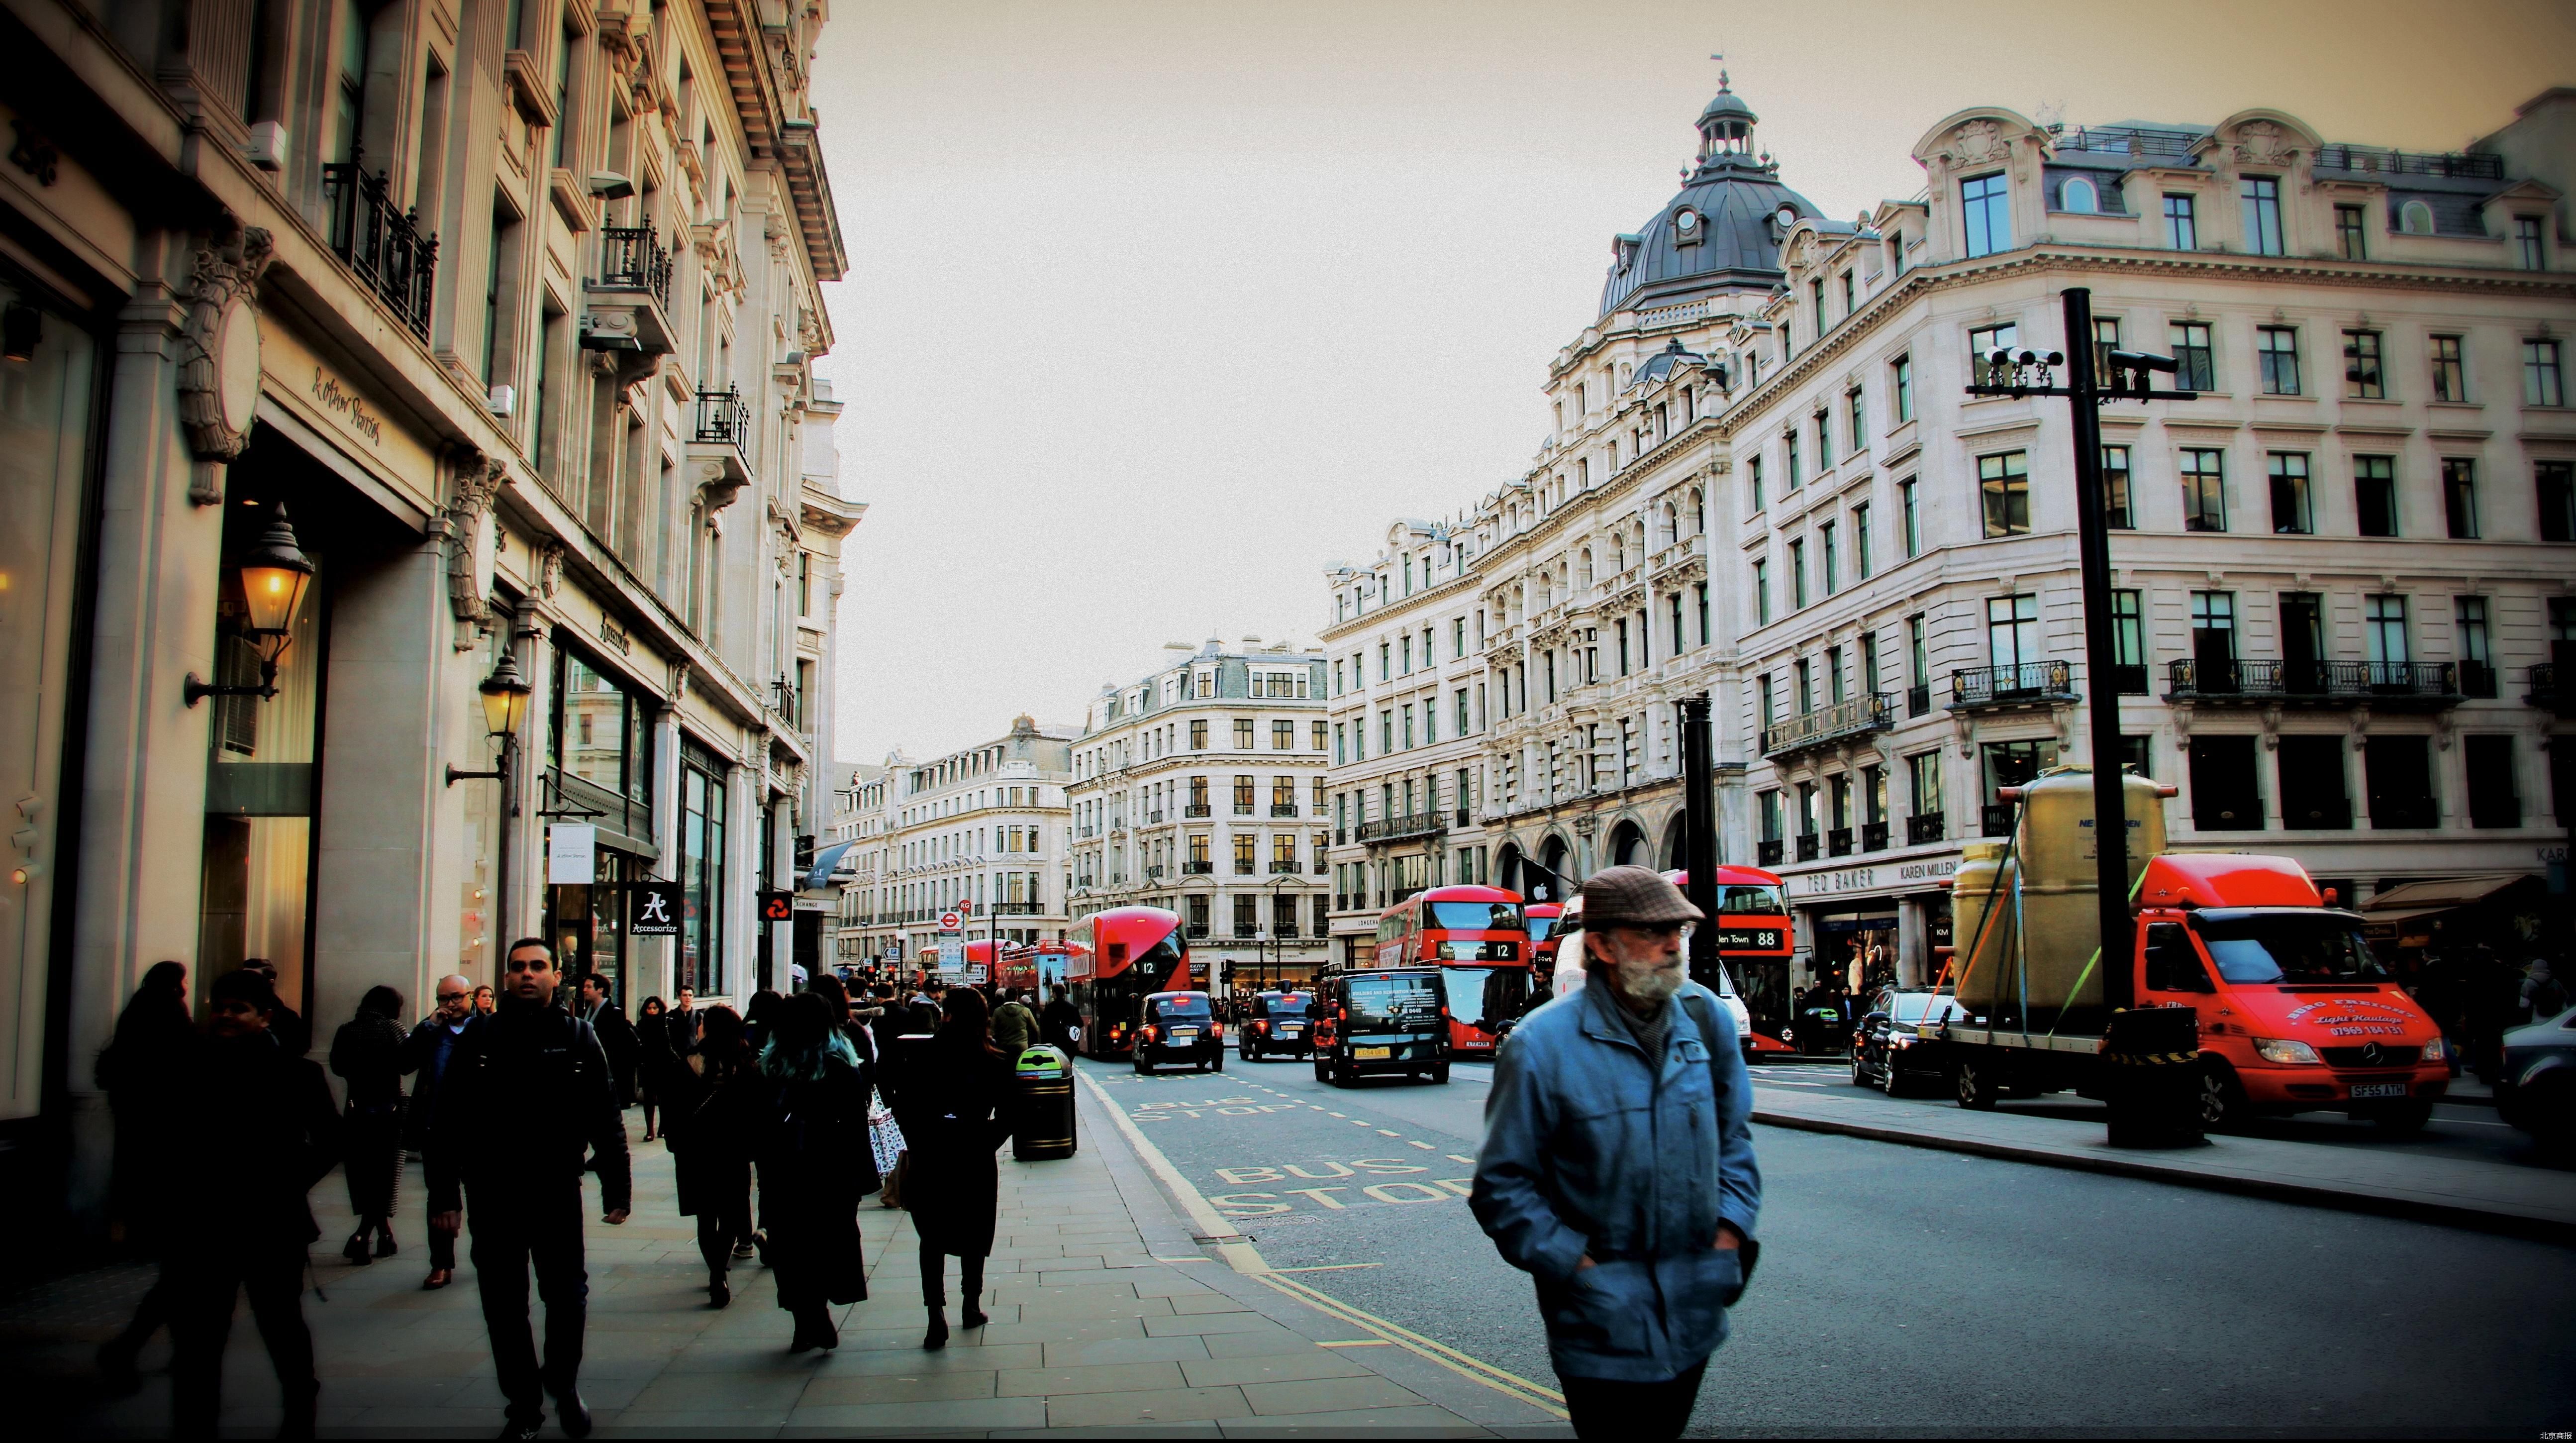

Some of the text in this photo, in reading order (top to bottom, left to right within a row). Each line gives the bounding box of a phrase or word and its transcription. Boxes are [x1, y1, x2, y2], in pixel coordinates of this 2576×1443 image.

[351, 397, 380, 447] Stories
[1900, 861, 1957, 879] KAREN MILLEN
[1807, 868, 1873, 892] TED BAKER
[632, 924, 677, 933] Accessorize
[1758, 932, 1775, 945] 88
[1497, 945, 1508, 956] 12
[1144, 963, 1154, 973] 12
[2285, 999, 2417, 1020] BURG FREIGHT
[2314, 1015, 2402, 1024] Light Haulage
[2355, 1084, 2403, 1096] SF55 ATH
[1134, 1095, 1258, 1112] BUS
[1129, 1104, 1296, 1122] STOP
[1214, 1158, 1429, 1185] BUS
